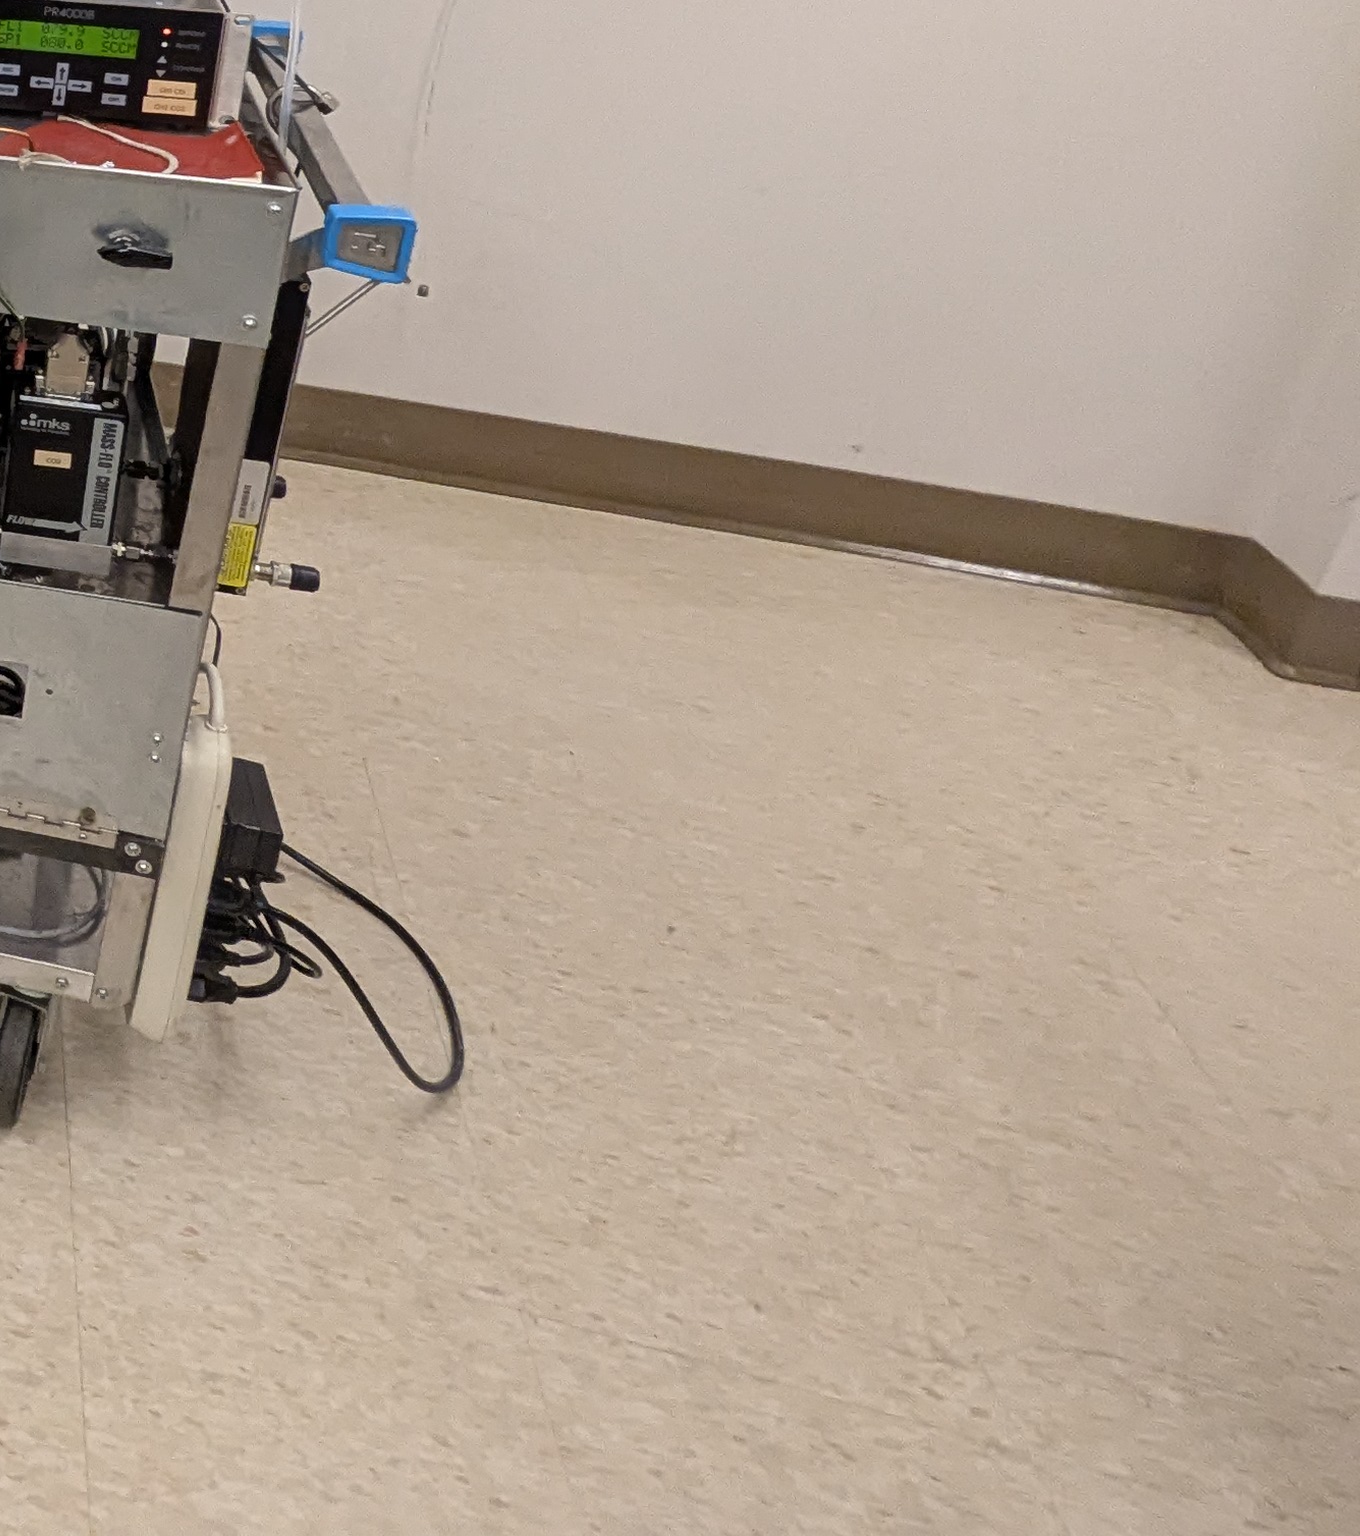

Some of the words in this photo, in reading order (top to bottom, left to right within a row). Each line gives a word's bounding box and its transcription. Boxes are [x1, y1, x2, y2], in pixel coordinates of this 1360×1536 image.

[37, 417, 71, 431] mks
[90, 476, 110, 529] CONTROLLER
[6, 514, 35, 526] FLOW
